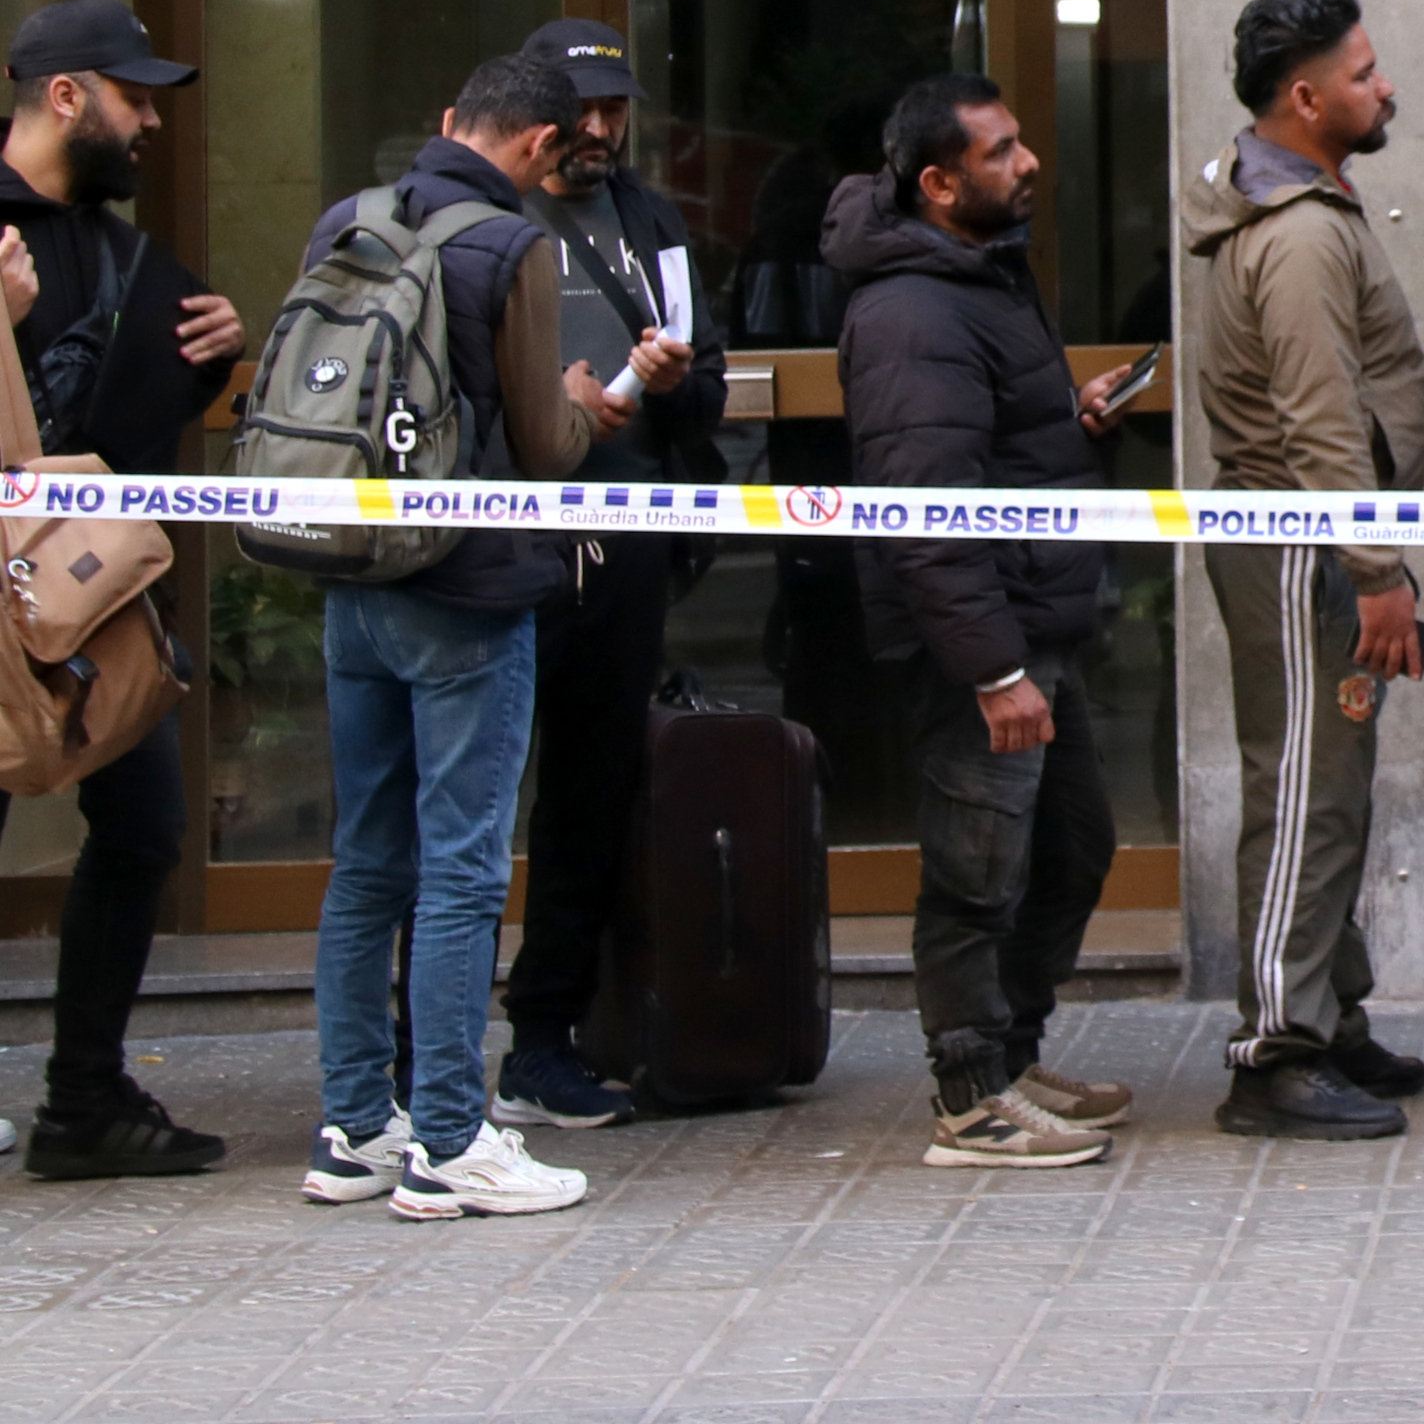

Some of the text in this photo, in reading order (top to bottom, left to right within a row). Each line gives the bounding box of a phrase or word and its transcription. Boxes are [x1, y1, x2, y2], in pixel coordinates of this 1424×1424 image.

[46, 483, 280, 516] NO PASSEU
[402, 491, 542, 521] POLICIA
[560, 508, 716, 527] Guàrdia Urbana
[851, 503, 1079, 534] NO PASSEU
[1198, 510, 1335, 537] POLICIA
